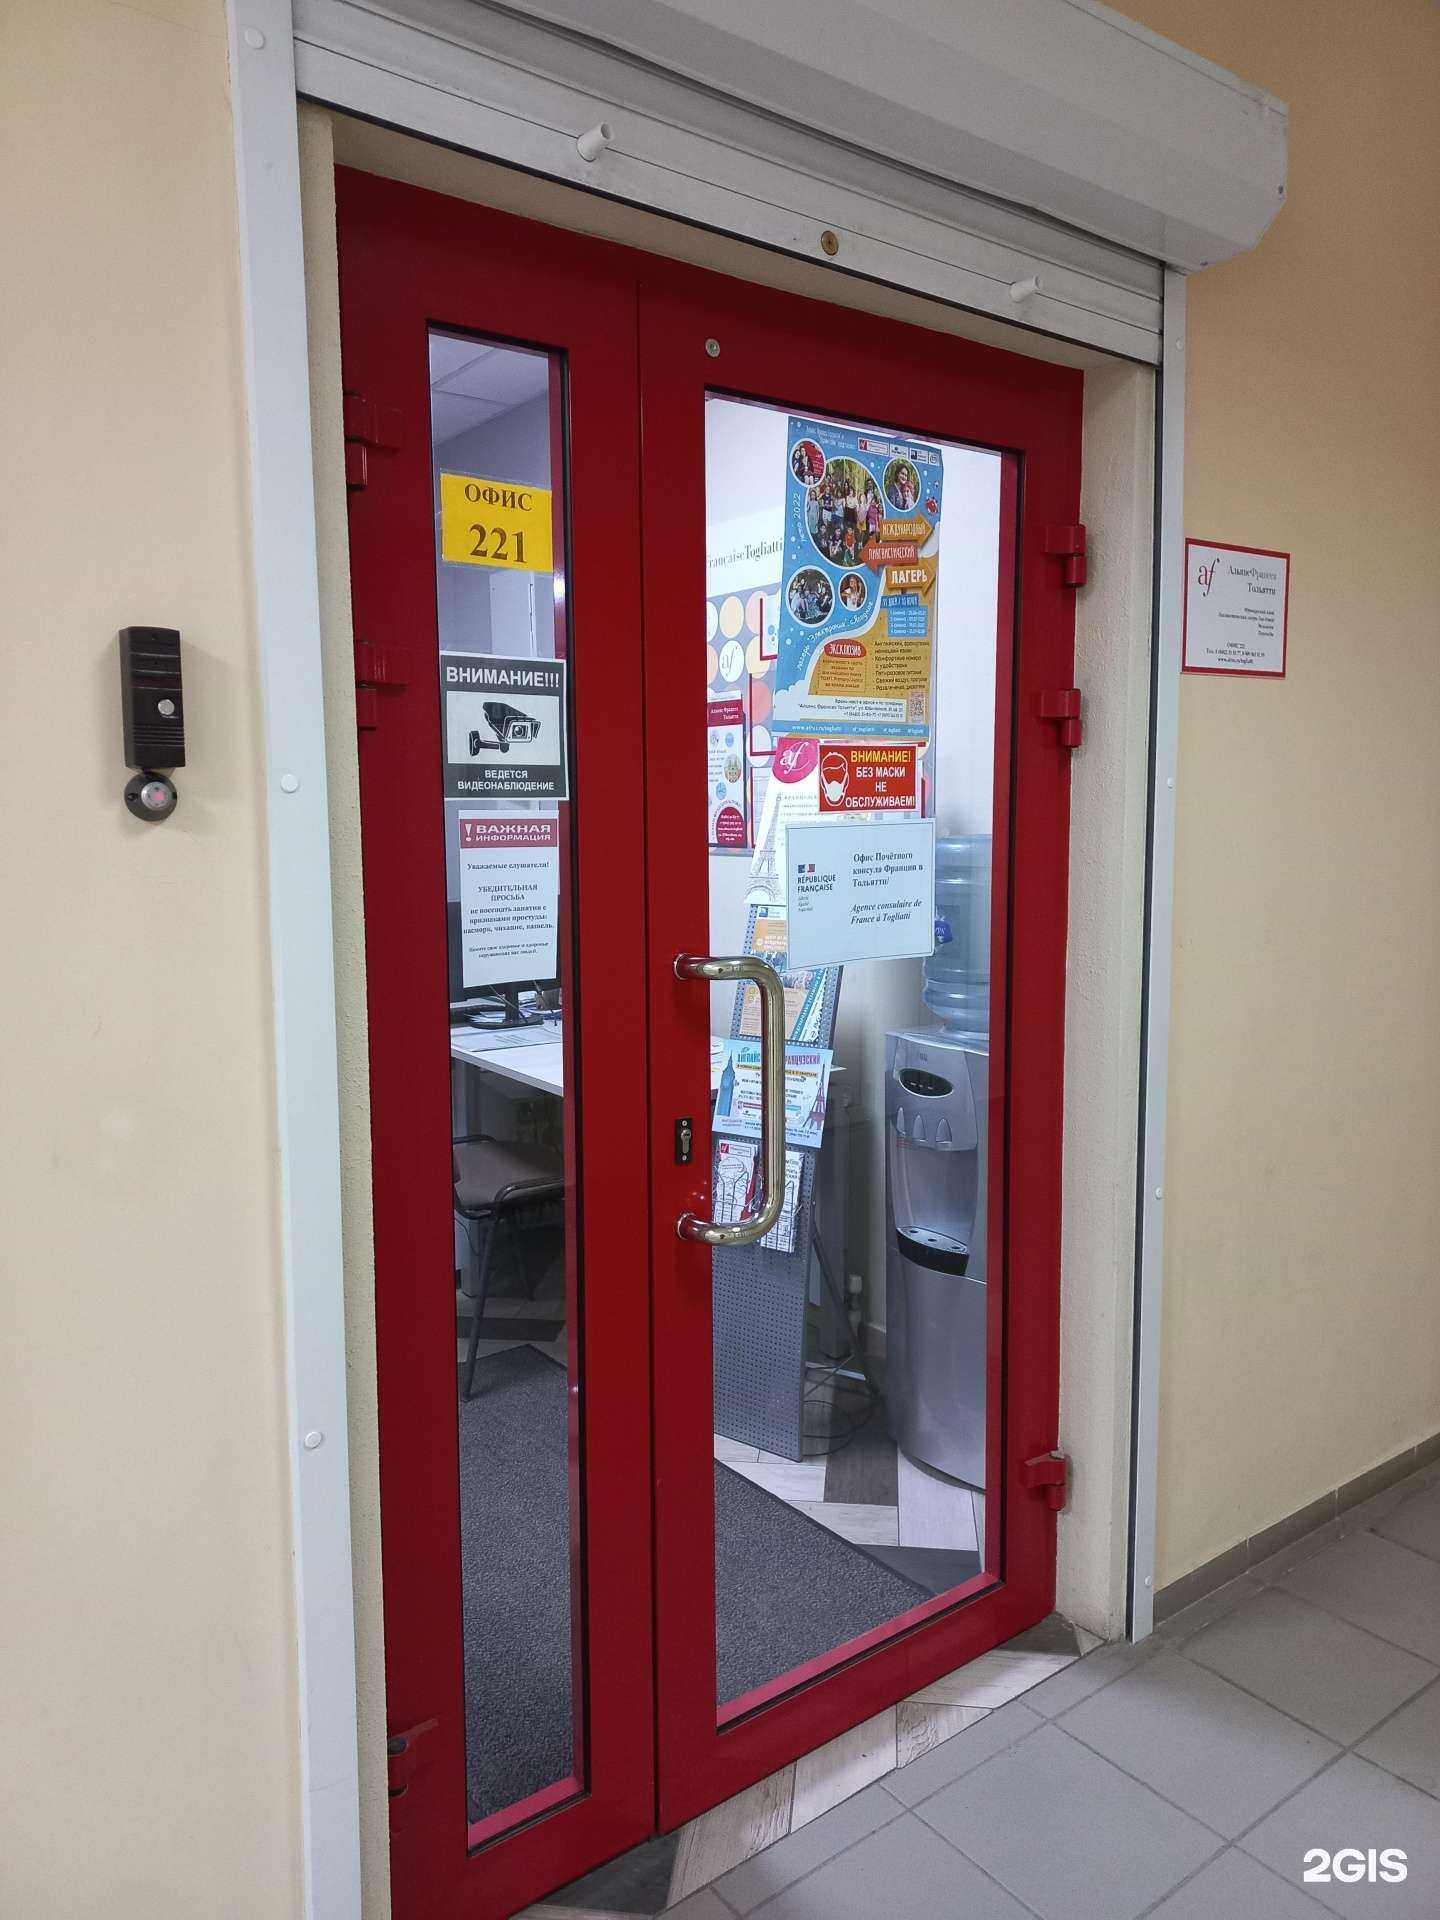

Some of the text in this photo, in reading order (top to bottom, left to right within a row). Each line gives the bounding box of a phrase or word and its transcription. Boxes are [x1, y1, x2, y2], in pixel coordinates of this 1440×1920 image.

[464, 483, 532, 511] ОФИС
[793, 493, 801, 519] 2022
[469, 523, 527, 563] 221
[891, 569, 928, 584] ЛАГЕРЬ
[828, 643, 861, 657] ЭКСКЛЮЗИВ
[446, 666, 560, 688] ВНИМАНИЕ!!!
[850, 750, 912, 763] ВНИМАНИЕ!
[485, 770, 528, 779] ВЕДЕТСЯ
[856, 766, 906, 778] БЕЗ МАСКИ
[458, 781, 554, 791] ВИДЕОНАБЛЮДЕНИЕ
[875, 782, 887, 793] НЕ
[845, 796, 916, 808] ОБСЛУЖИВАЕМ!
[476, 824, 551, 834] ВАЖНАЯ
[476, 834, 551, 842] ИНФОРМАЦИЯ
[853, 851, 913, 864] Офис Почётного
[853, 866, 883, 875] консула
[884, 864, 917, 874] Франции
[798, 874, 836, 884] RÉPUBLIQUE
[478, 884, 538, 893] УБЕДИТЕЛЬНАЯ
[798, 883, 833, 893] FRANÇAISE
[491, 894, 525, 902] ПРОСЬБА
[851, 899, 922, 914] Agence consulaire de
[851, 915, 875, 925] France
[883, 912, 911, 923] Togliatti
